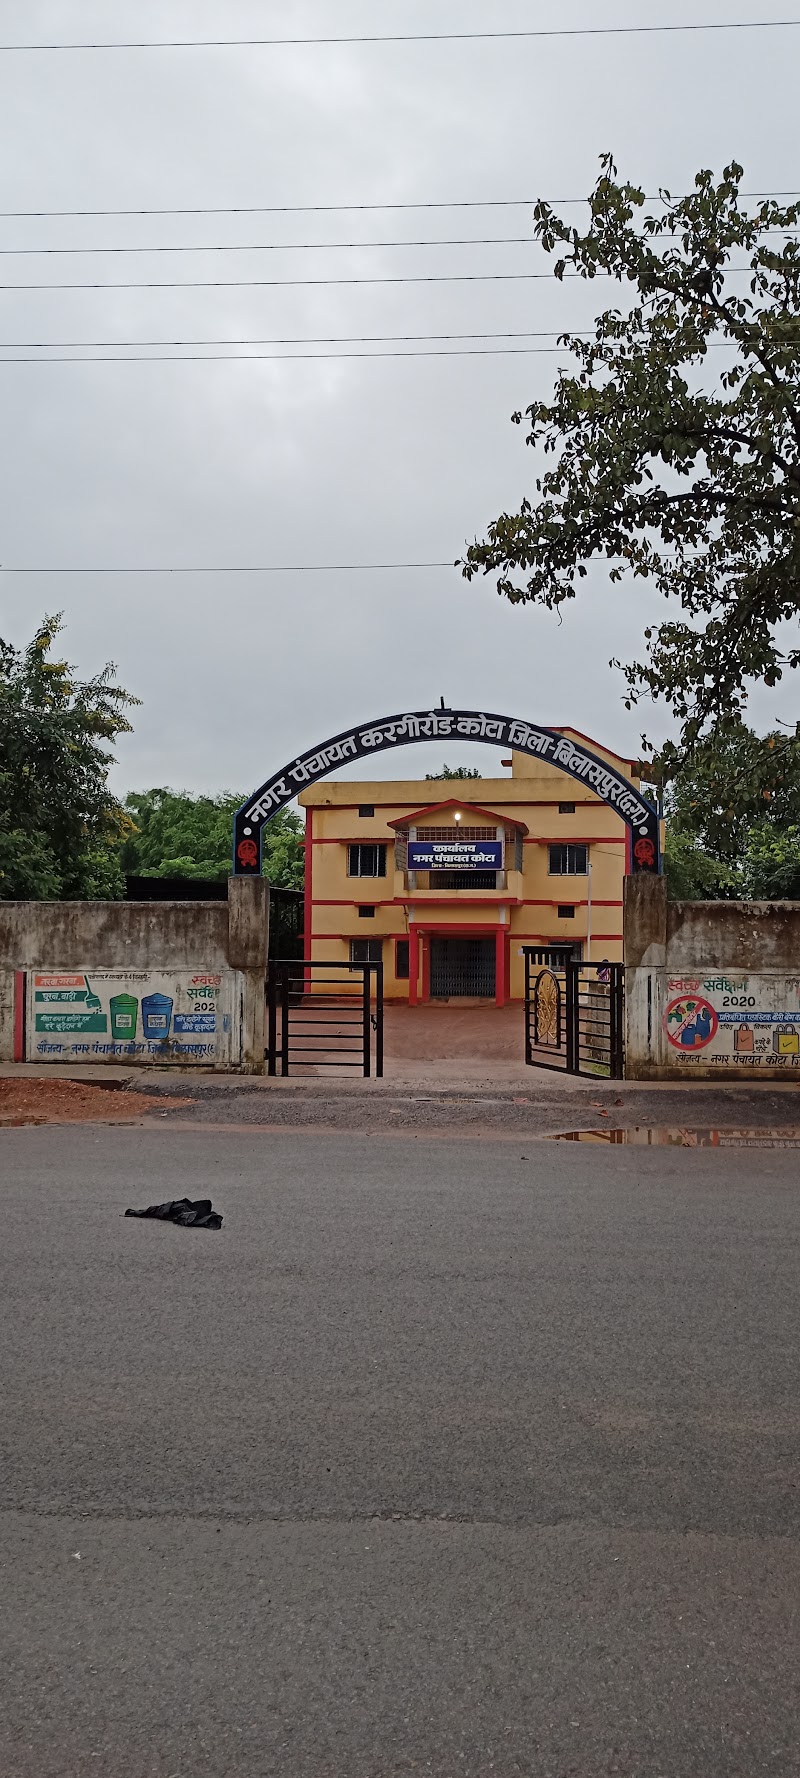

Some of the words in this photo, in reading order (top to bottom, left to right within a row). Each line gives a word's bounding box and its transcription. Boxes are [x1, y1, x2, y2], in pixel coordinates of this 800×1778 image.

[245, 777, 291, 822] नगर
[288, 735, 358, 782] पंचायत
[432, 843, 476, 852] कार्यालय
[413, 854, 434, 862] नगर
[435, 853, 469, 862] पंचायत
[469, 852, 496, 862] कोटा
[668, 980, 699, 991] स्वच्छ
[723, 997, 755, 1006] 2020
[194, 1003, 218, 1011] 202
[710, 1054, 730, 1065] नगर
[732, 1052, 763, 1066] पंचायत
[766, 1053, 788, 1066] कोटा
